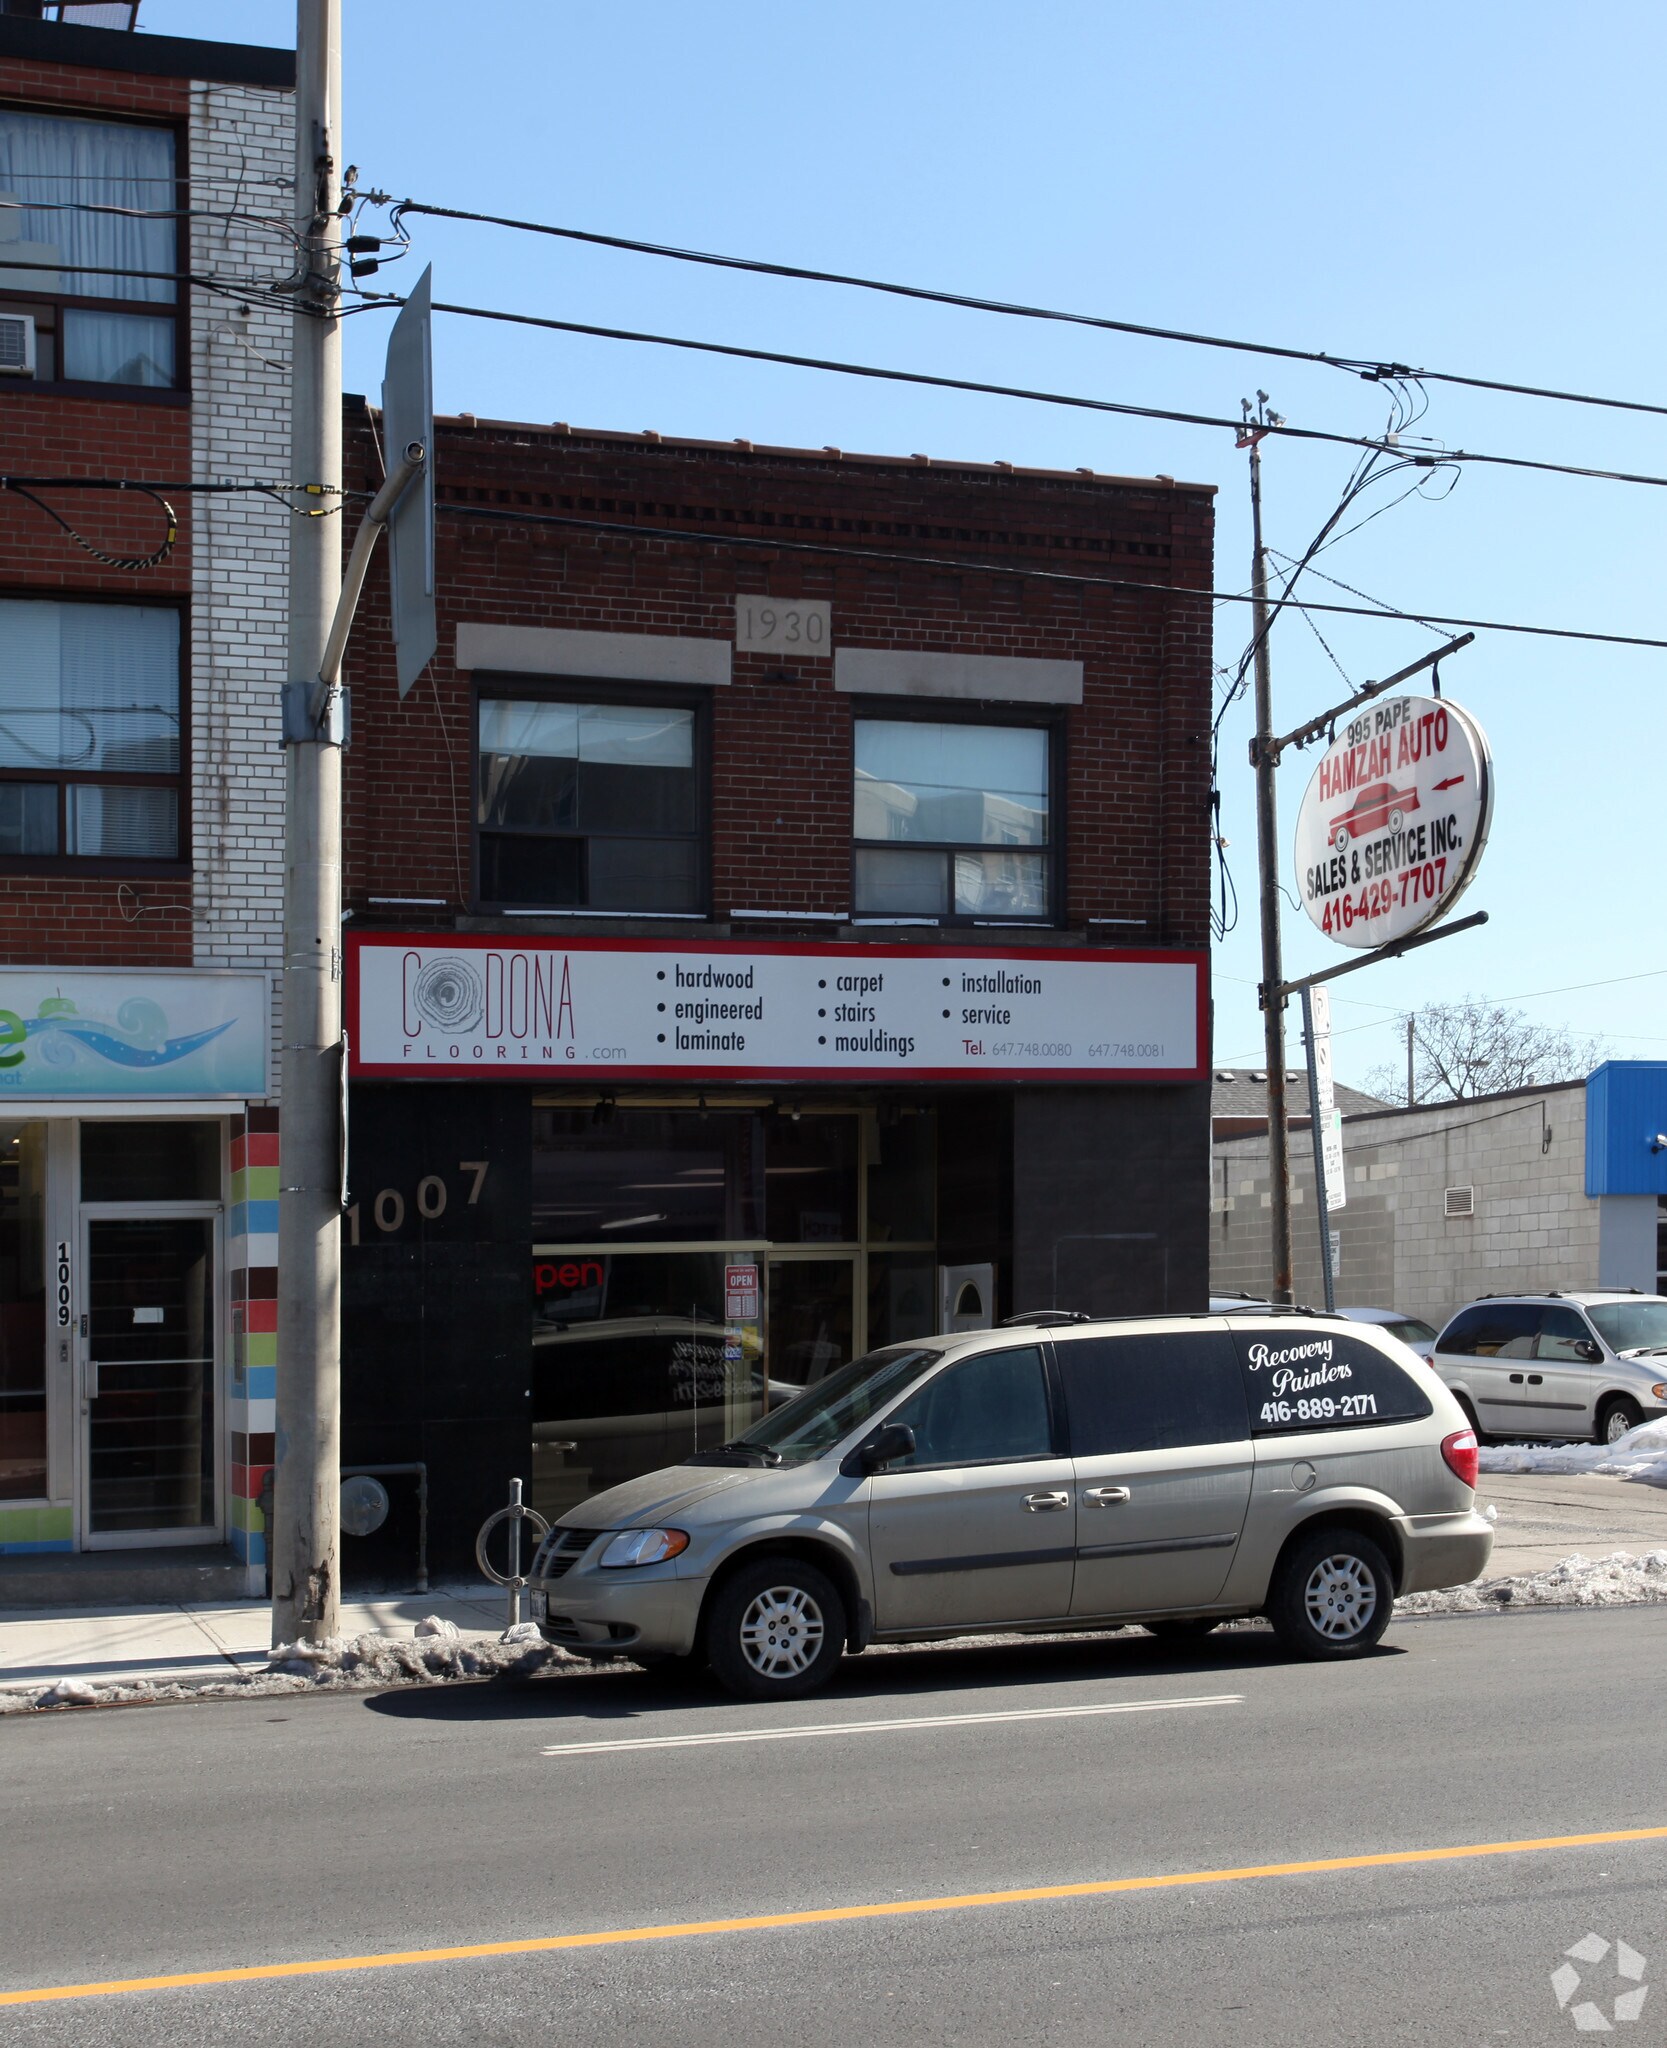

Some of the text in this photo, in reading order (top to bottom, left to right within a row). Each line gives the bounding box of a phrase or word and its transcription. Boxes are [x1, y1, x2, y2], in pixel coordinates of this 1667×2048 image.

[746, 607, 823, 644] 1930
[1346, 698, 1411, 748] 995 PAPE
[1319, 707, 1448, 802] HAMZAH AUTO
[1306, 813, 1463, 901] SALES & SERVICE INC.
[1322, 857, 1448, 935] 416-429-7707
[675, 964, 754, 989] hardwood
[836, 974, 884, 997] carpet
[961, 971, 1042, 995] installation
[674, 996, 763, 1024] engineered
[834, 1002, 876, 1023] stairs
[961, 1004, 1011, 1025] service
[675, 1028, 745, 1051] laminate
[835, 1029, 915, 1057] mouldings
[962, 1040, 1165, 1058] Tel. 647.748.0080 647.748.0081
[345, 1161, 490, 1246] 1007
[59, 1243, 70, 1326] 1009
[532, 1262, 605, 1295] pen
[730, 1274, 753, 1287] OPEN
[1248, 1339, 1333, 1371] Recovery
[1271, 1362, 1353, 1397] Painters
[1260, 1394, 1378, 1423] 416-889-2171
